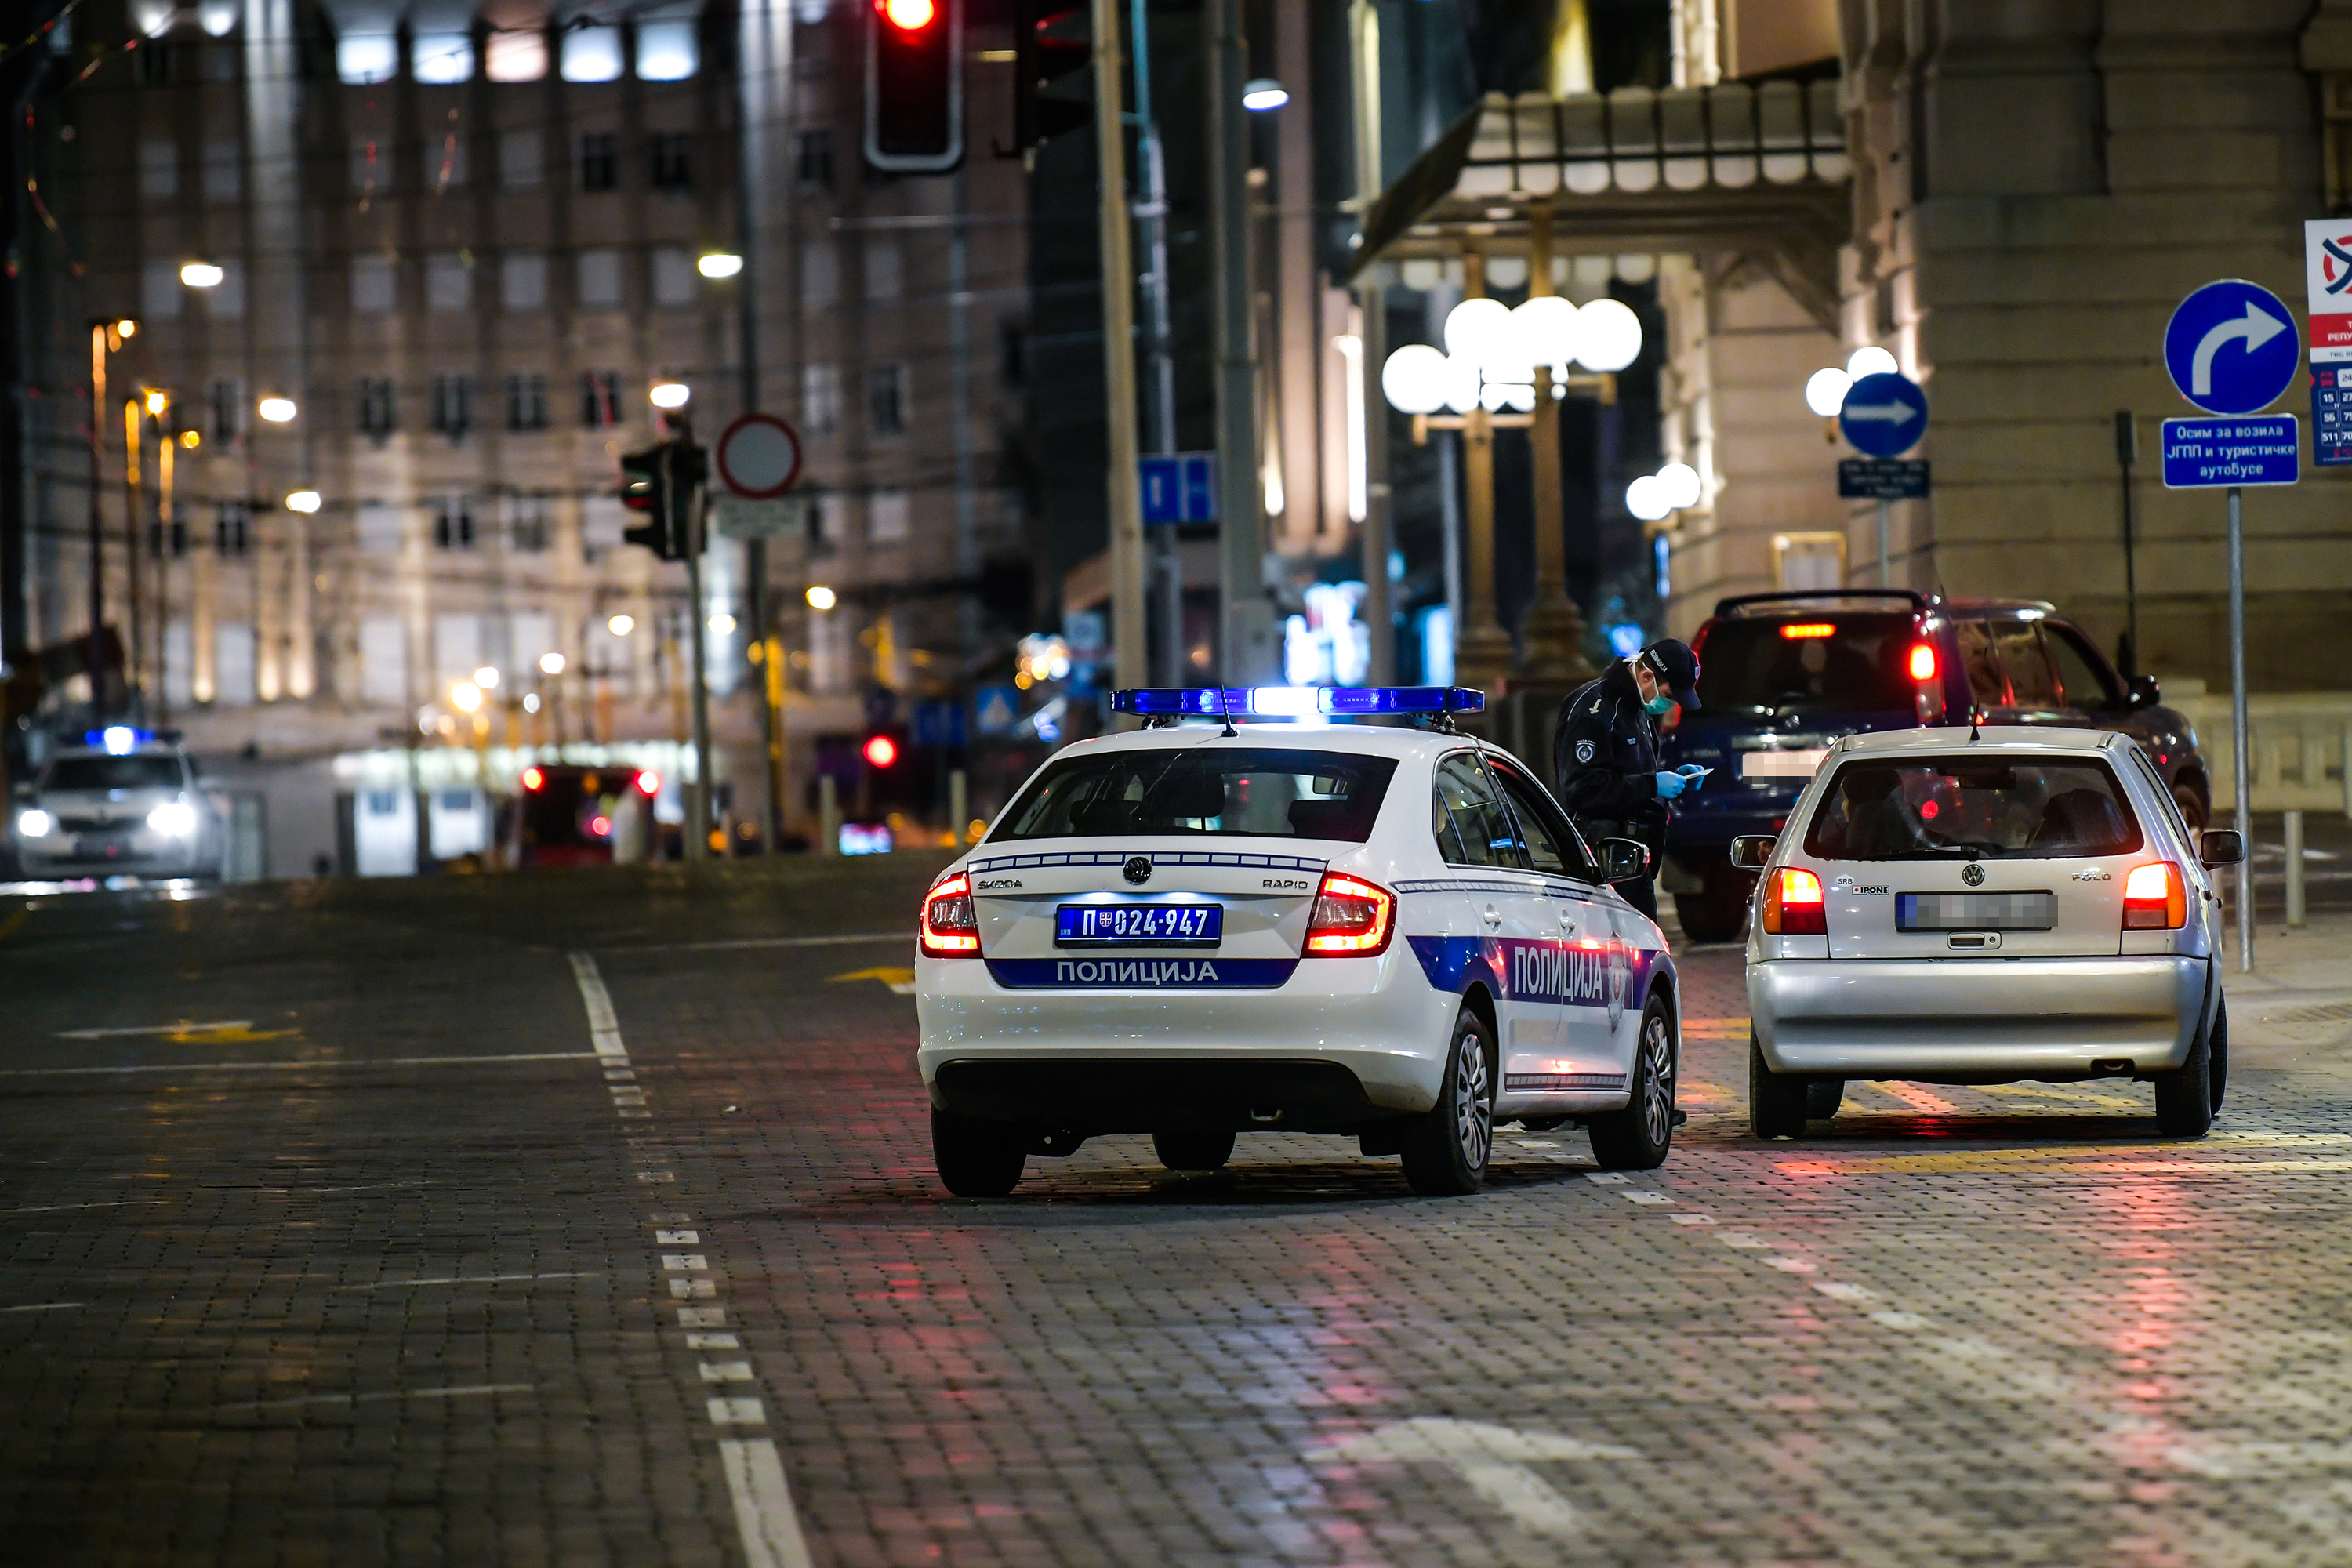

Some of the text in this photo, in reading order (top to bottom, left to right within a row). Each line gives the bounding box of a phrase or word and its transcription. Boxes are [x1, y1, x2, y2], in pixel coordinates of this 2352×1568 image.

[2323, 393, 2334, 403] 15
[2176, 426, 2284, 440] Осим за возила
[2167, 445, 2296, 459] ЈГПП и туристичке
[2200, 463, 2263, 479] аутобусе
[2071, 871, 2112, 881] POLO
[1262, 879, 1308, 889] RAPID
[1082, 909, 1096, 935] П
[1057, 961, 1219, 985] ПОЛИЦИЈА
[1514, 946, 1603, 1002] ПОЛИЦИЈА
